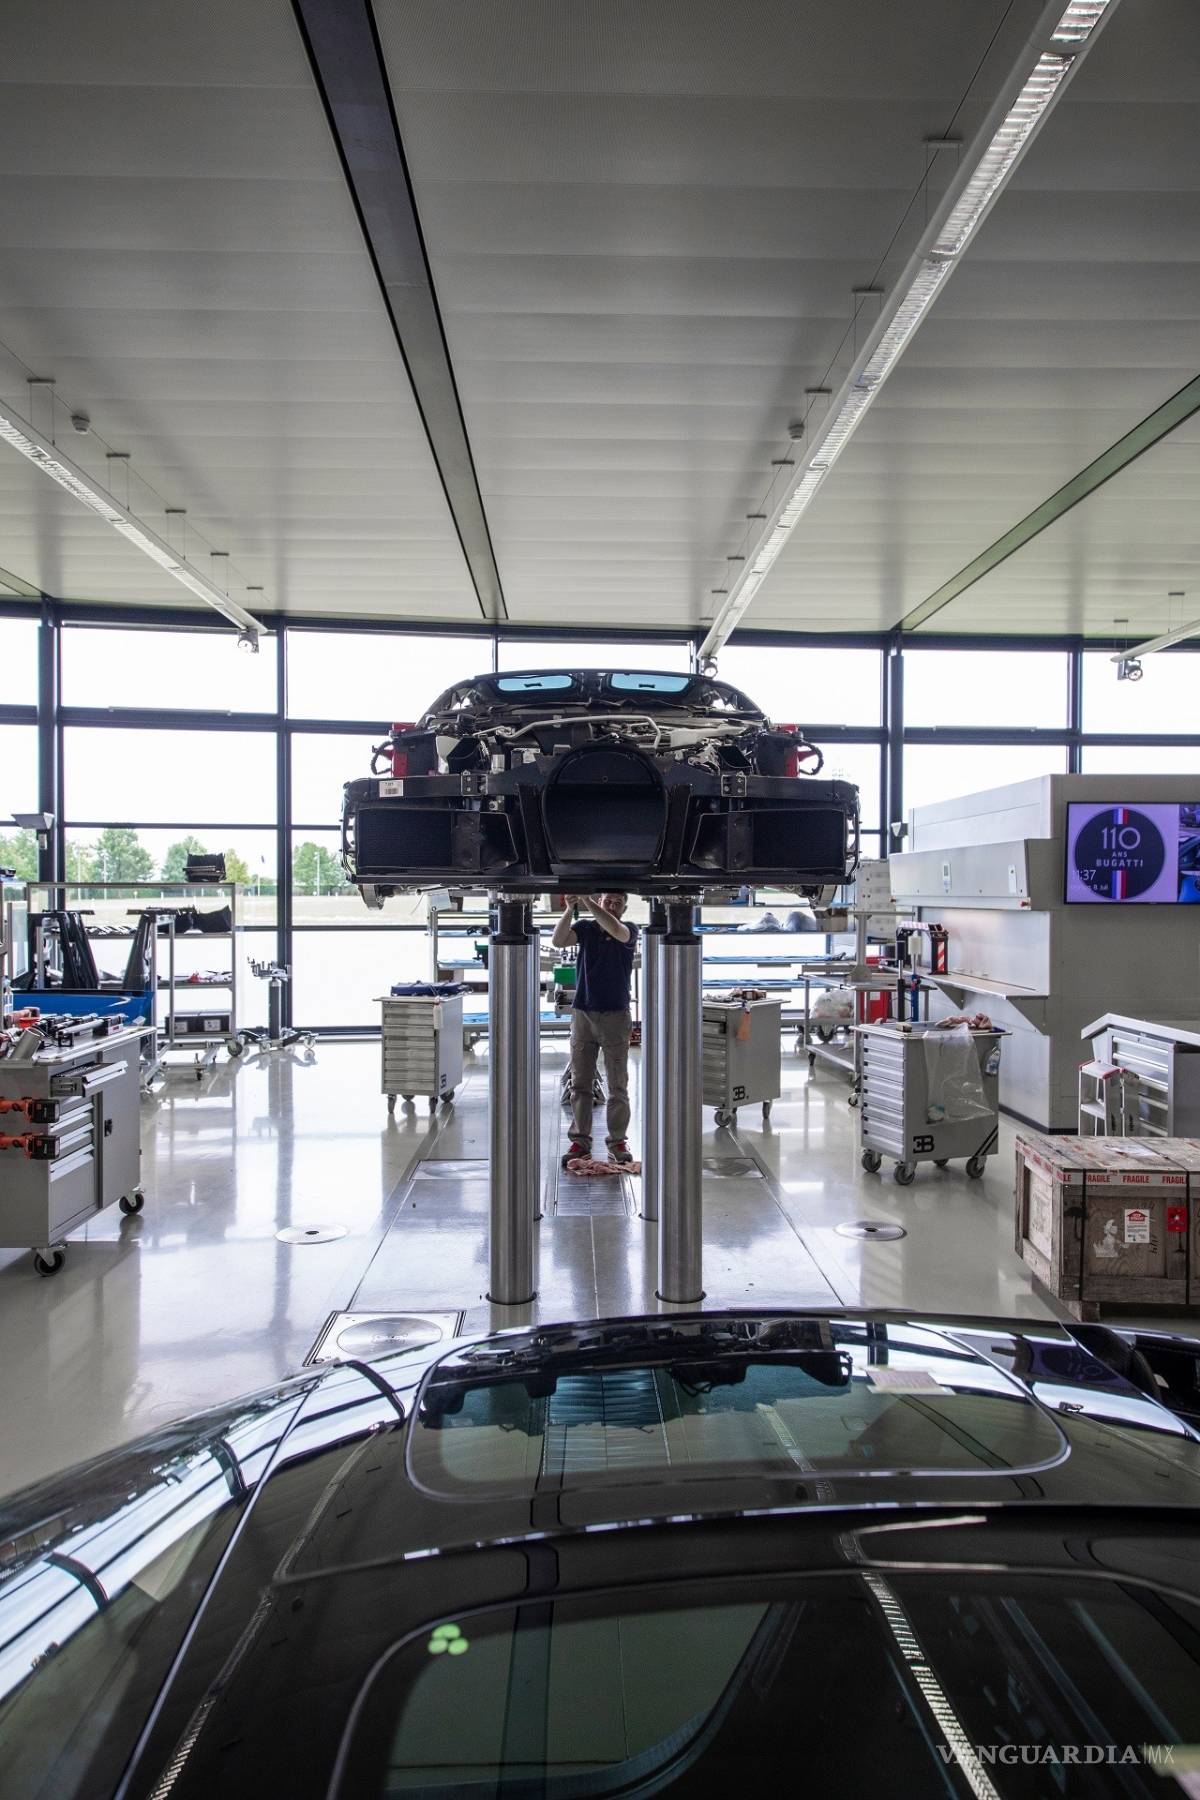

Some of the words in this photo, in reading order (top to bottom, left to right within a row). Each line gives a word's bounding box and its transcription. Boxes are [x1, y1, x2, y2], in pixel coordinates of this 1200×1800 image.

[1102, 827, 1140, 849] 110
[1096, 859, 1144, 867] BUGATTI
[1087, 1174, 1111, 1183] RAGILE
[1122, 1175, 1150, 1184] FRAGILE
